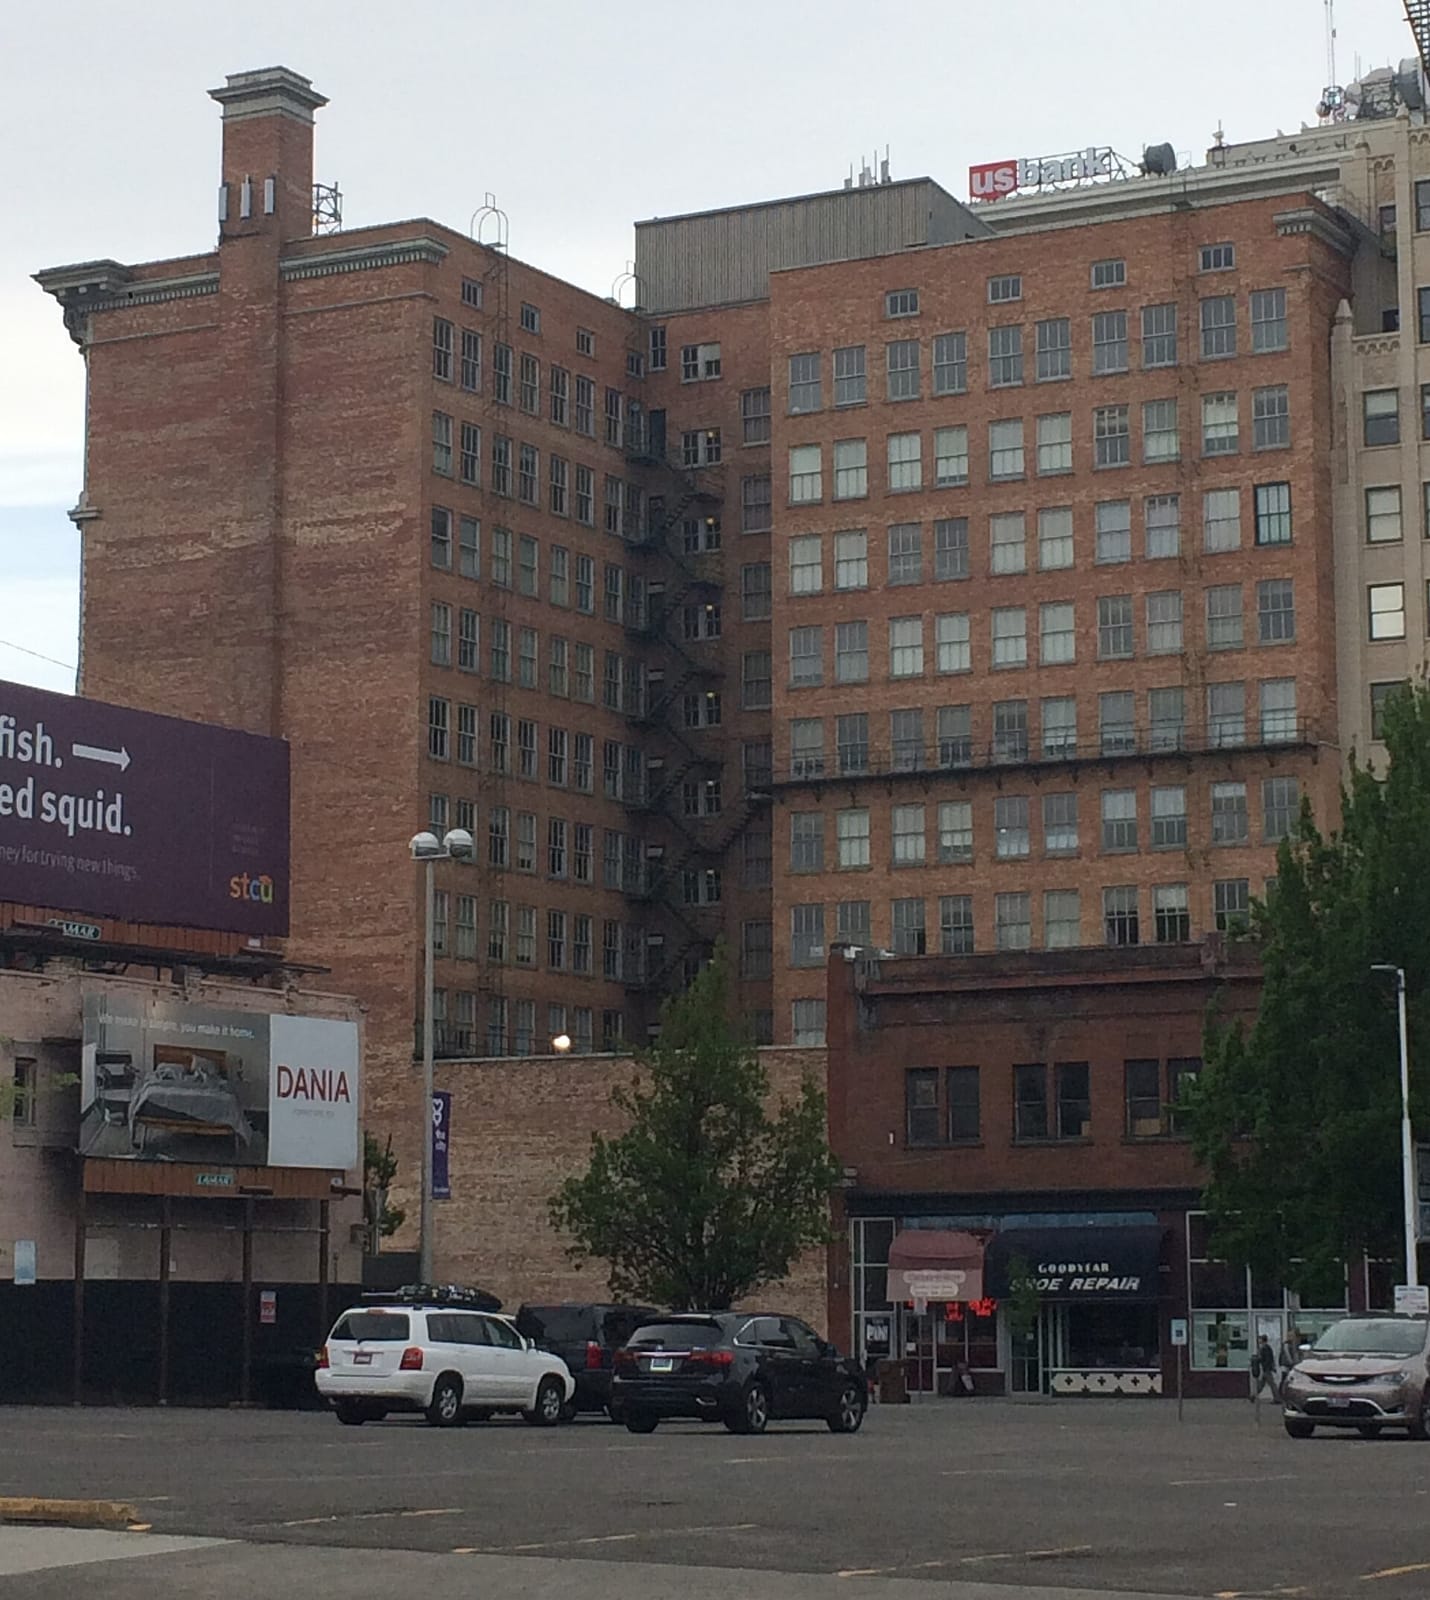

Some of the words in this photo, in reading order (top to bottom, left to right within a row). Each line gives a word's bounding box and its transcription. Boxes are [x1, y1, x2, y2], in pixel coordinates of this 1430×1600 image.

[41, 790, 131, 836] squid.
[22, 845, 39, 863] for
[230, 872, 273, 903] stcu
[277, 1065, 350, 1103] DANIA
[1069, 1277, 1140, 1290] REPAIR
